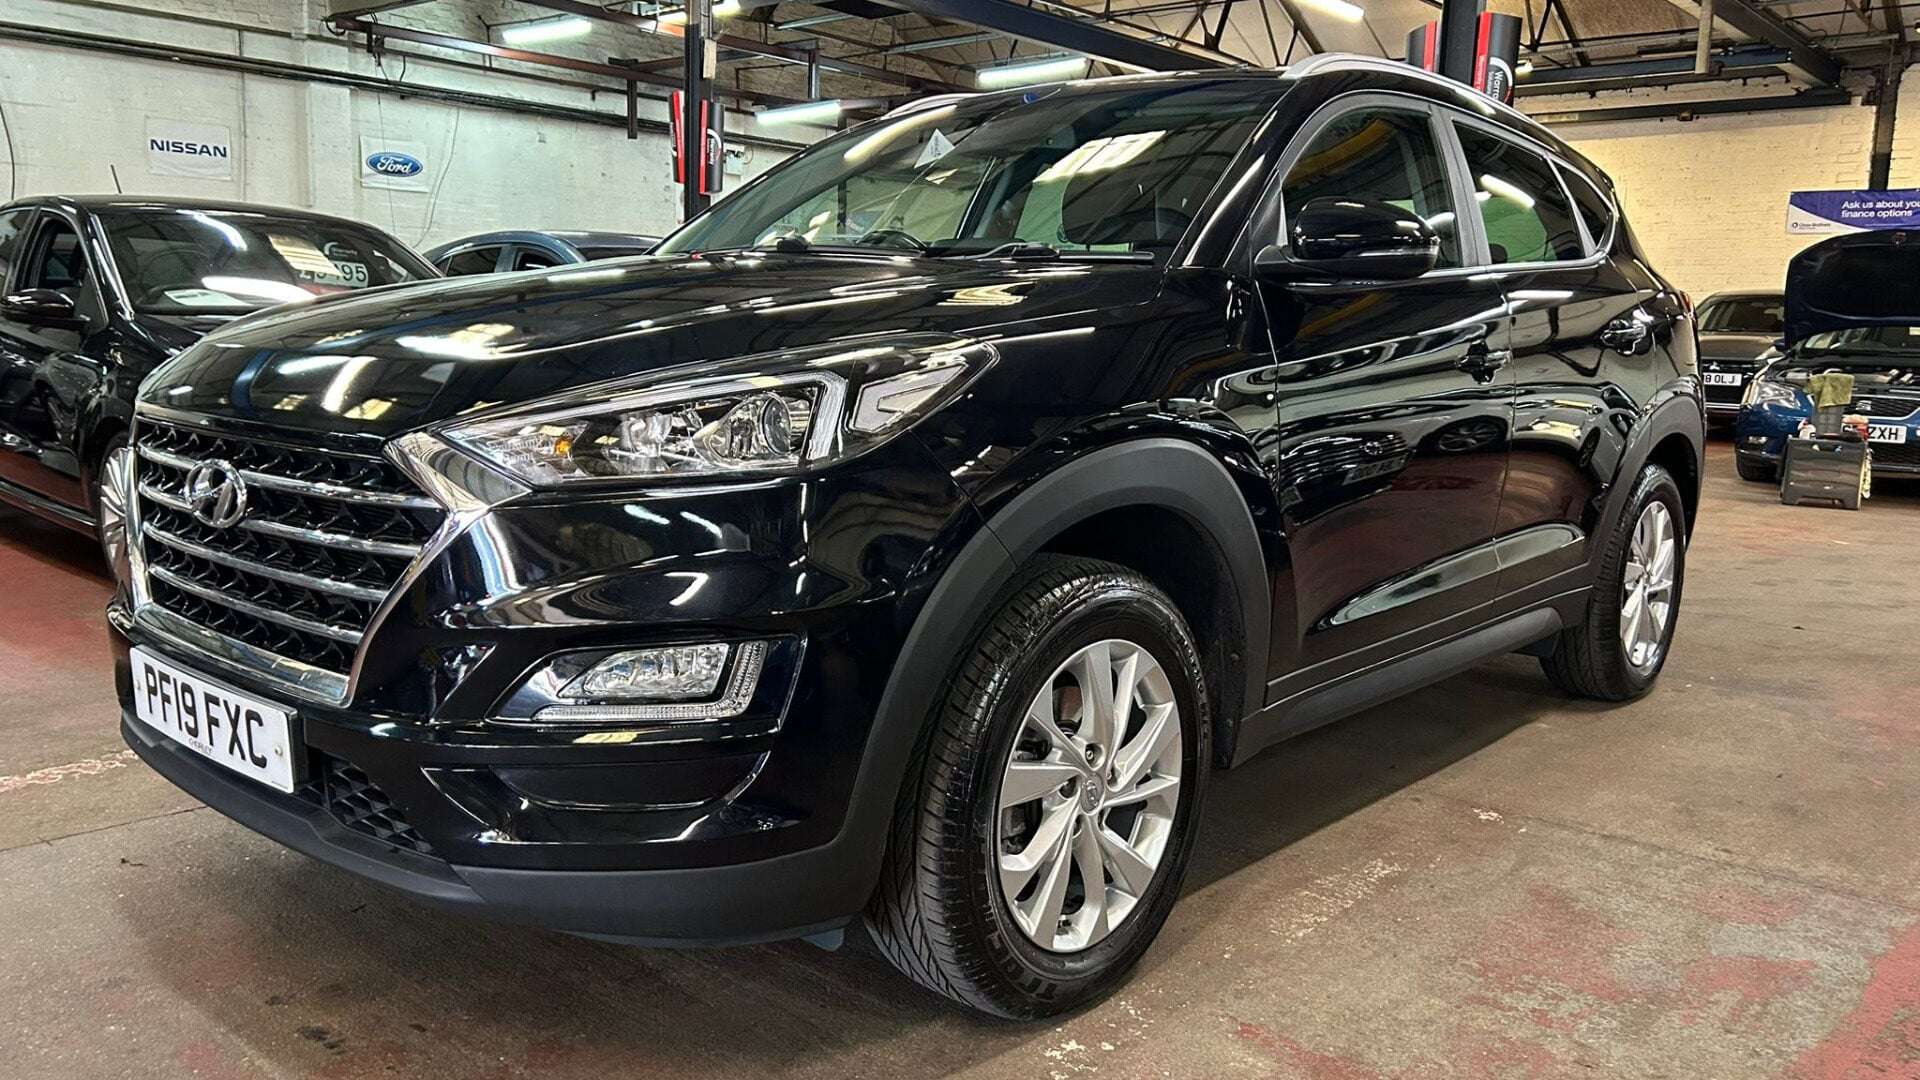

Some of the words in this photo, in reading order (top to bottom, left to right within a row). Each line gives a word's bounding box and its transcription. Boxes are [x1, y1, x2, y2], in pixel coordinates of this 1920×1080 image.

[150, 139, 227, 158] NISSAN
[376, 156, 413, 174] Ford
[1841, 201, 1860, 209] Ask
[1875, 200, 1904, 209] about
[1841, 209, 1875, 218] finance
[1876, 209, 1913, 219] options
[1867, 426, 1899, 440] ZXH
[144, 662, 199, 738] PF19
[203, 691, 268, 769] FXC
